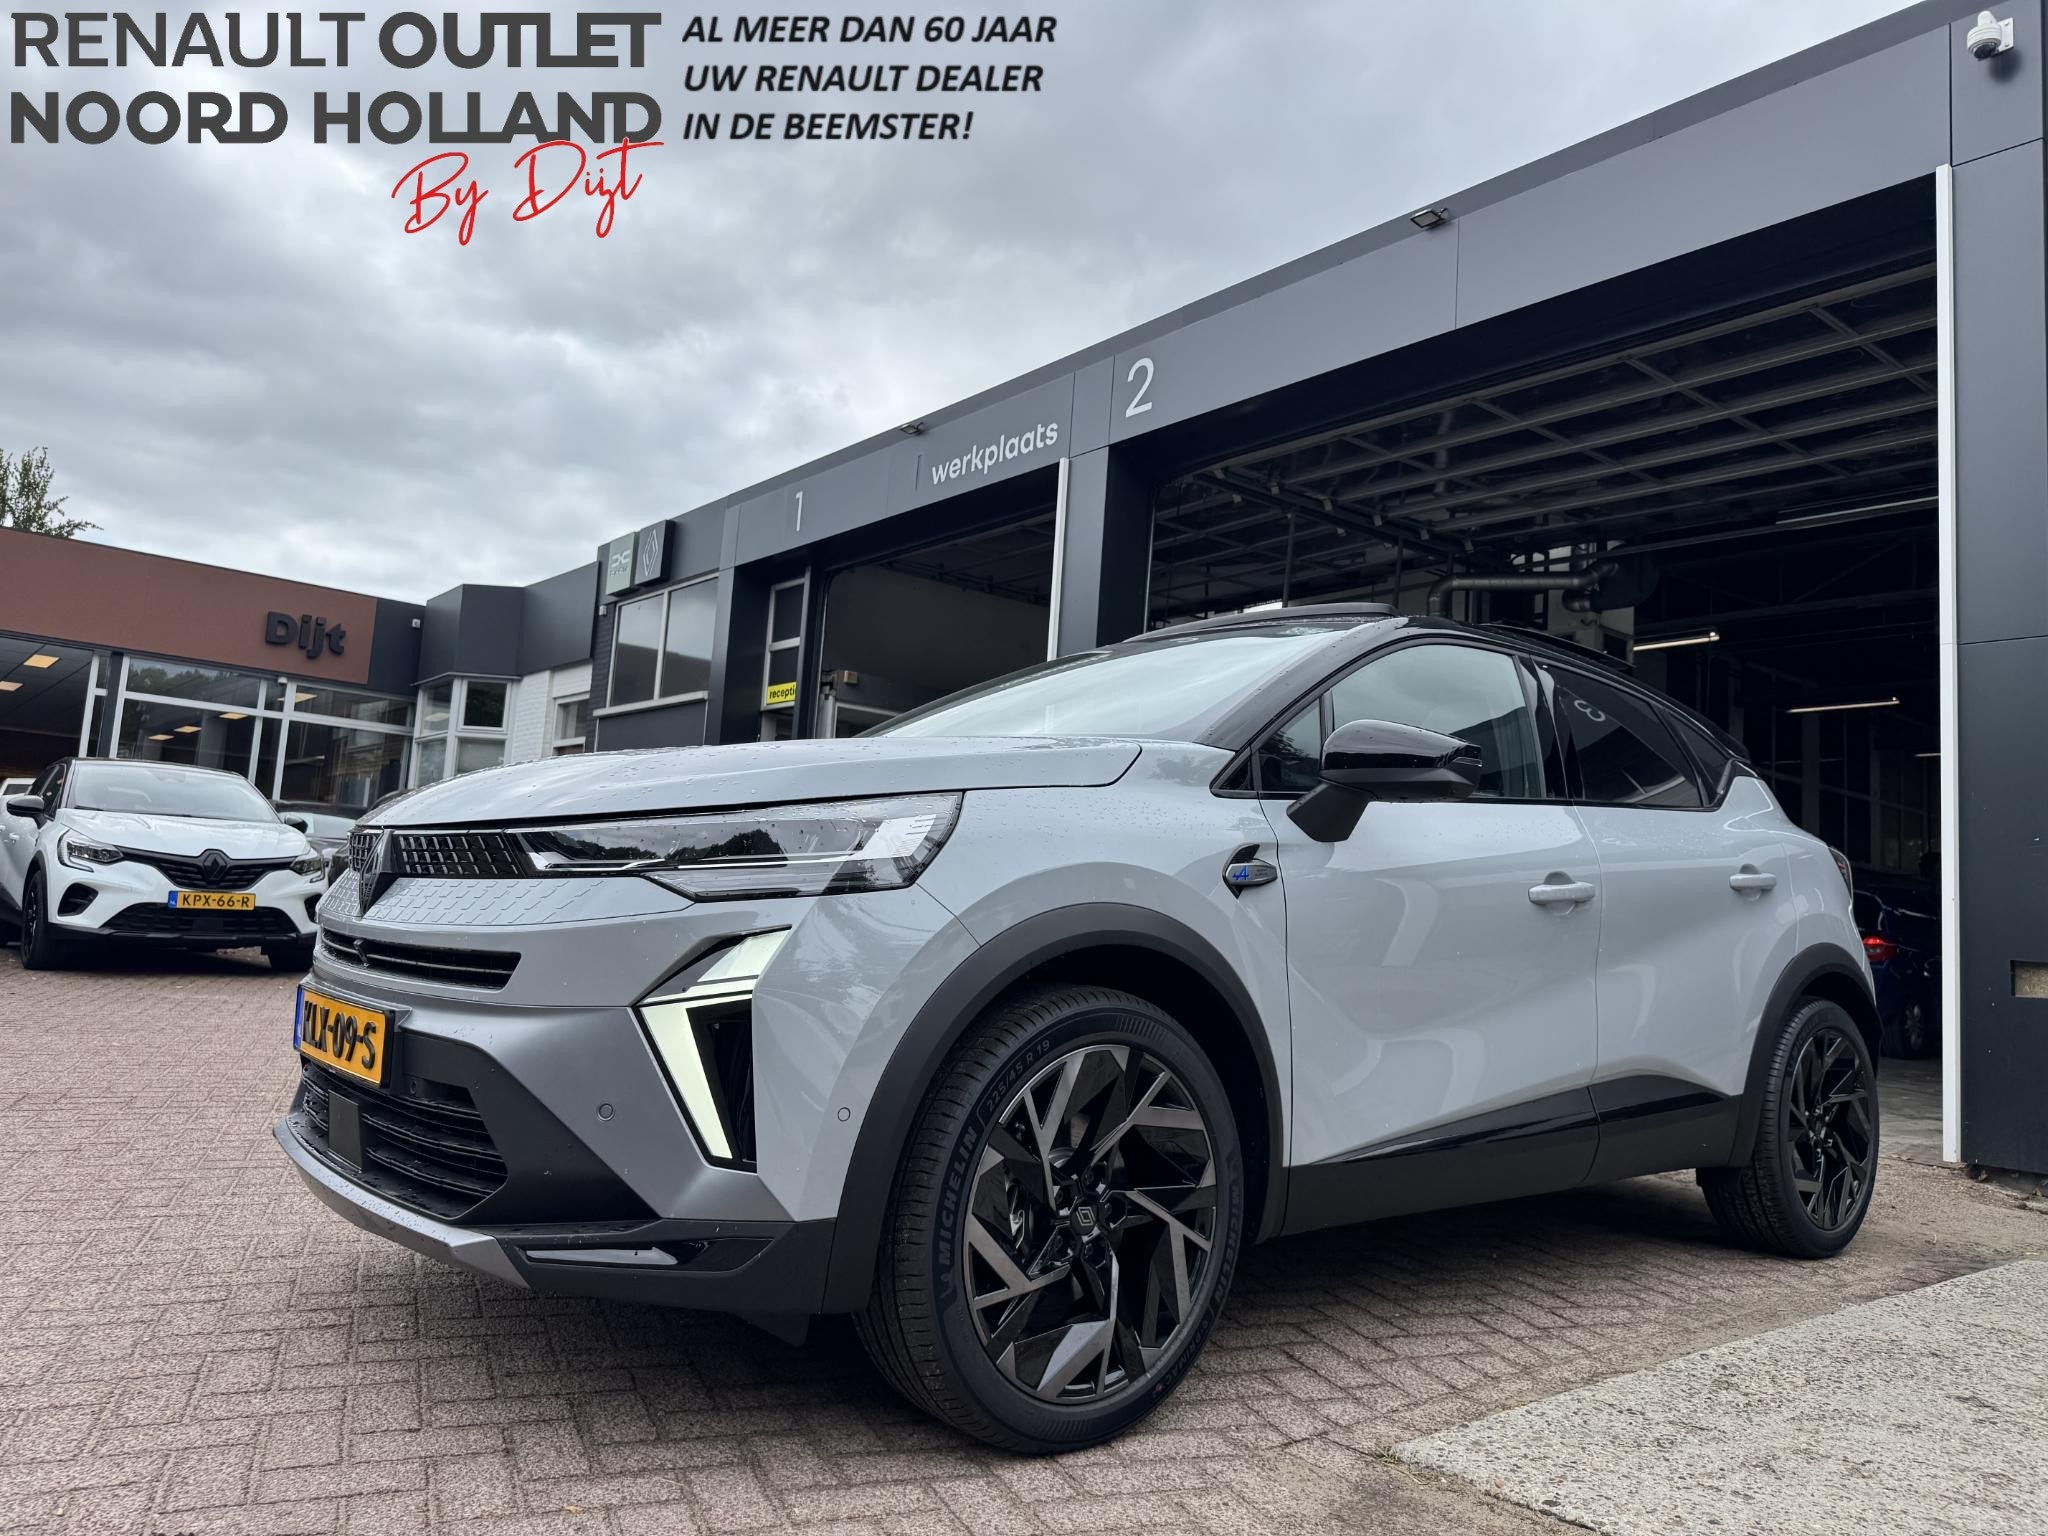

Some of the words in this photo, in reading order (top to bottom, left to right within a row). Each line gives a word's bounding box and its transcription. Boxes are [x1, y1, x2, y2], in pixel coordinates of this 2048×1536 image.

[1126, 358, 1154, 418] 2
[931, 422, 1058, 485] werkplaats
[795, 491, 803, 532] 1
[265, 611, 346, 660] Dijt
[182, 893, 250, 908] KPX-66-R
[303, 1000, 377, 1070] KLX-09-S
[987, 1063, 1024, 1112] 225/45
[1027, 1052, 1035, 1063] R
[1038, 1039, 1050, 1054] 19
[939, 1125, 978, 1265] MICHELIN
